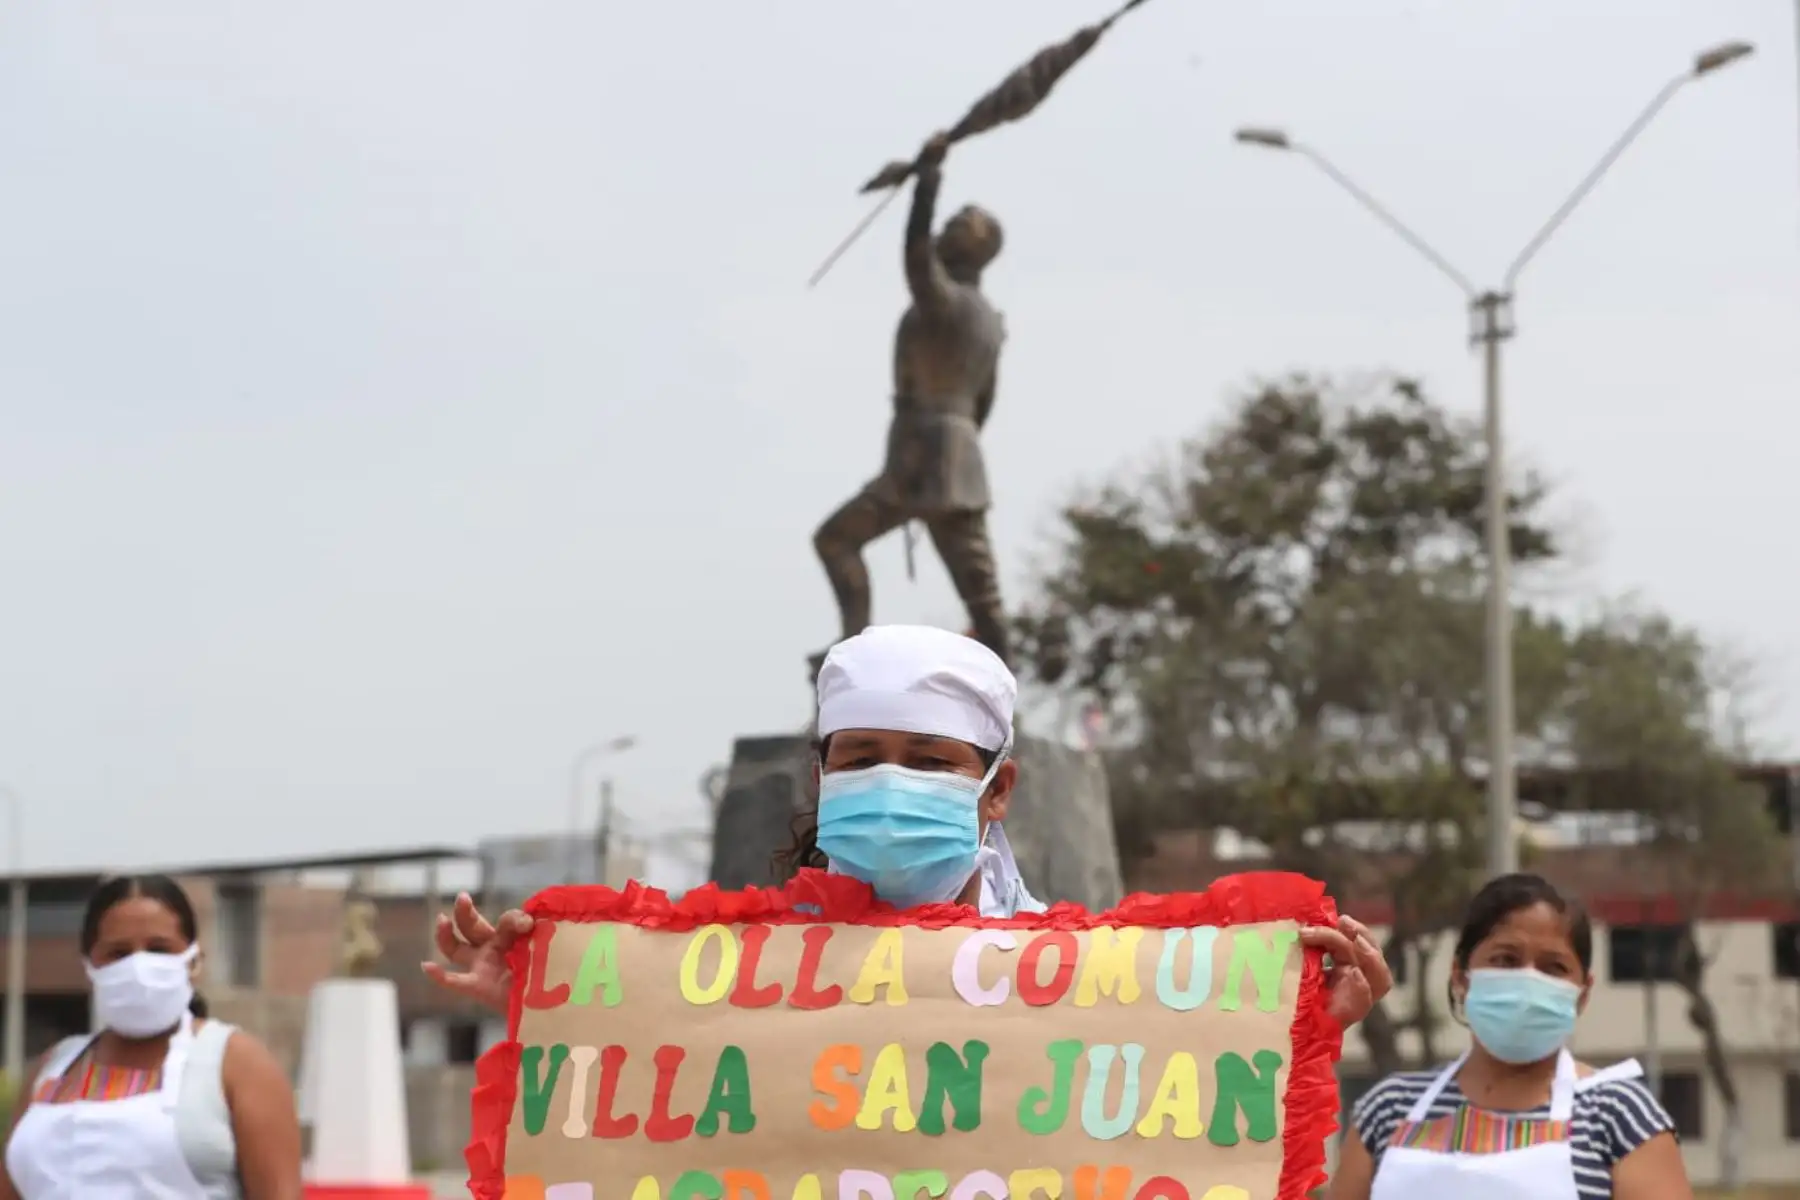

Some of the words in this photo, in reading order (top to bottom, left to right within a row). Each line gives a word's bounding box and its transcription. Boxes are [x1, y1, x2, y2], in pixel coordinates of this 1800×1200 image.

[524, 920, 623, 1009] LA
[680, 924, 908, 1009] OLLA
[952, 926, 1298, 1012] COMUN
[521, 1043, 756, 1142] VILLA
[808, 1039, 990, 1136] SAN
[1017, 1039, 1283, 1146] JUAN
